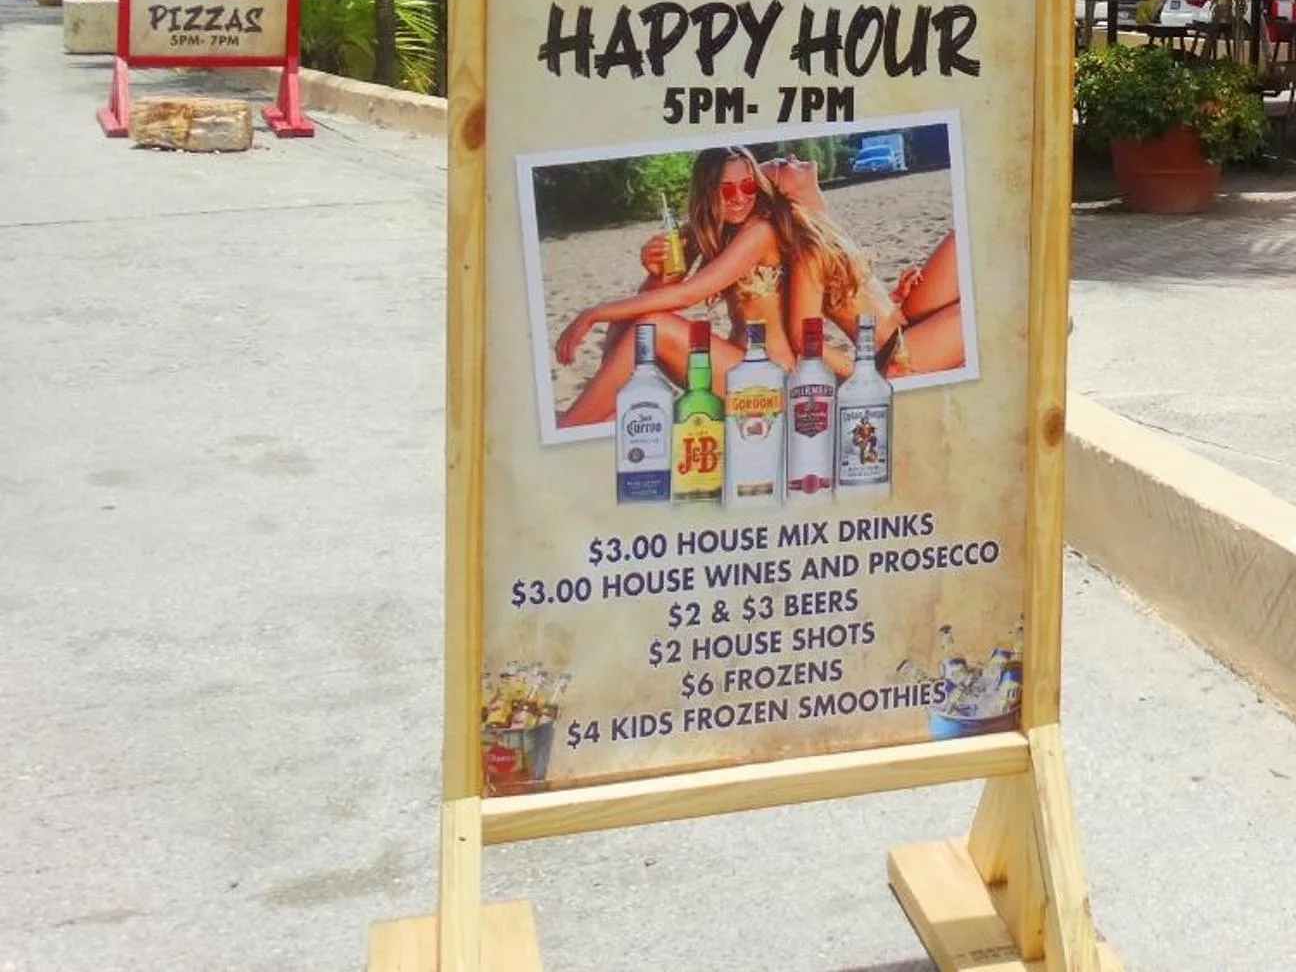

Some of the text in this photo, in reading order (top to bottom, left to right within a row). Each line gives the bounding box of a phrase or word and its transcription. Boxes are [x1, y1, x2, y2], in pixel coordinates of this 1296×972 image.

[148, 4, 264, 33] PIZZAS
[210, 34, 240, 46] 7PM
[789, 2, 981, 79] HOUR
[663, 85, 855, 125] 5PM- 7PM
[588, 512, 935, 566] $3.00 HOUSE MIX DRINKS
[511, 540, 1000, 608] $3.00 HOUSE WINES AND PROSECCO
[668, 588, 859, 630] $2 & $3 BEERS
[648, 621, 876, 668] $2 HOUSE SHOTS
[680, 658, 844, 700] $6 FROZENS
[566, 681, 947, 750] $4 KIDS FROZEN SMOOTHIES
